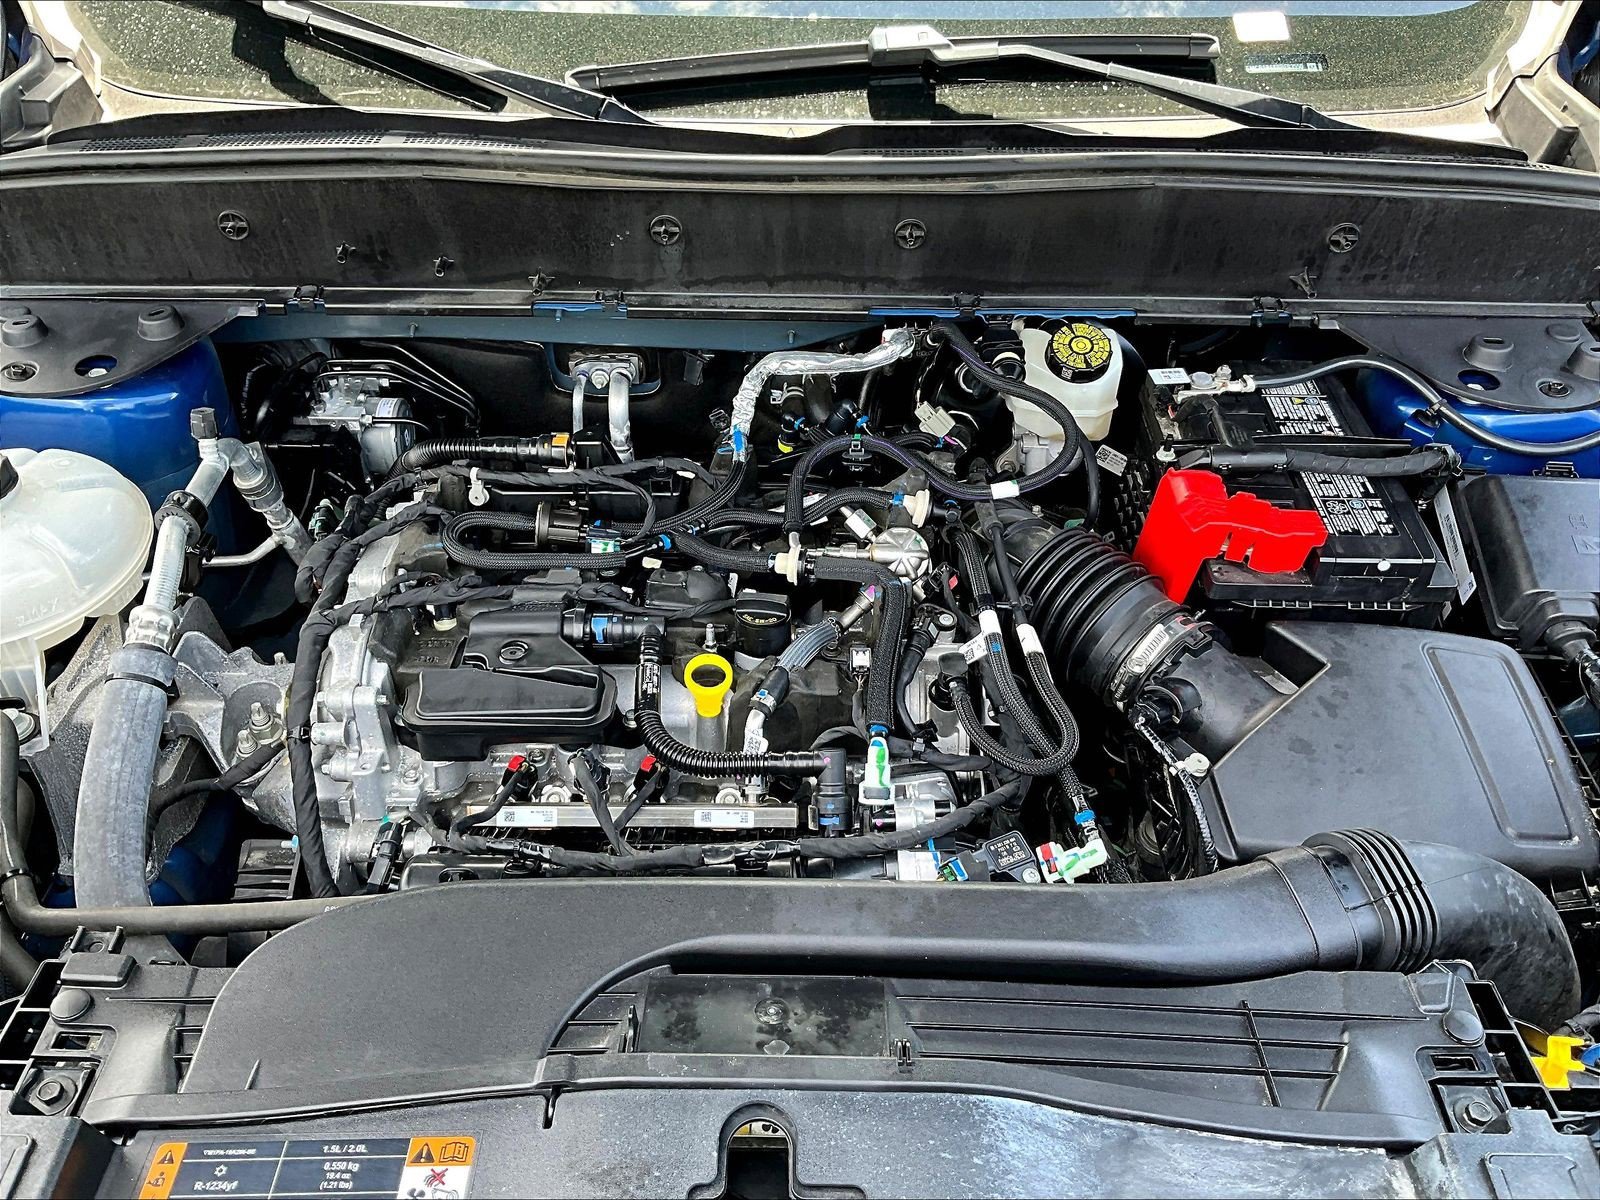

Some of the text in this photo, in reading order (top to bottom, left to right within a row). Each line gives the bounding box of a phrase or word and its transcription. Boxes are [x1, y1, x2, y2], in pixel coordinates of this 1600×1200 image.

[323, 1145, 341, 1153] 1.5L
[348, 1144, 368, 1153] 2.0L
[323, 1161, 360, 1172] 0.550 kg
[325, 1172, 341, 1180] 19.4
[193, 1180, 238, 1192] R-1234yf
[319, 1180, 353, 1191] (1.21 lbs)
